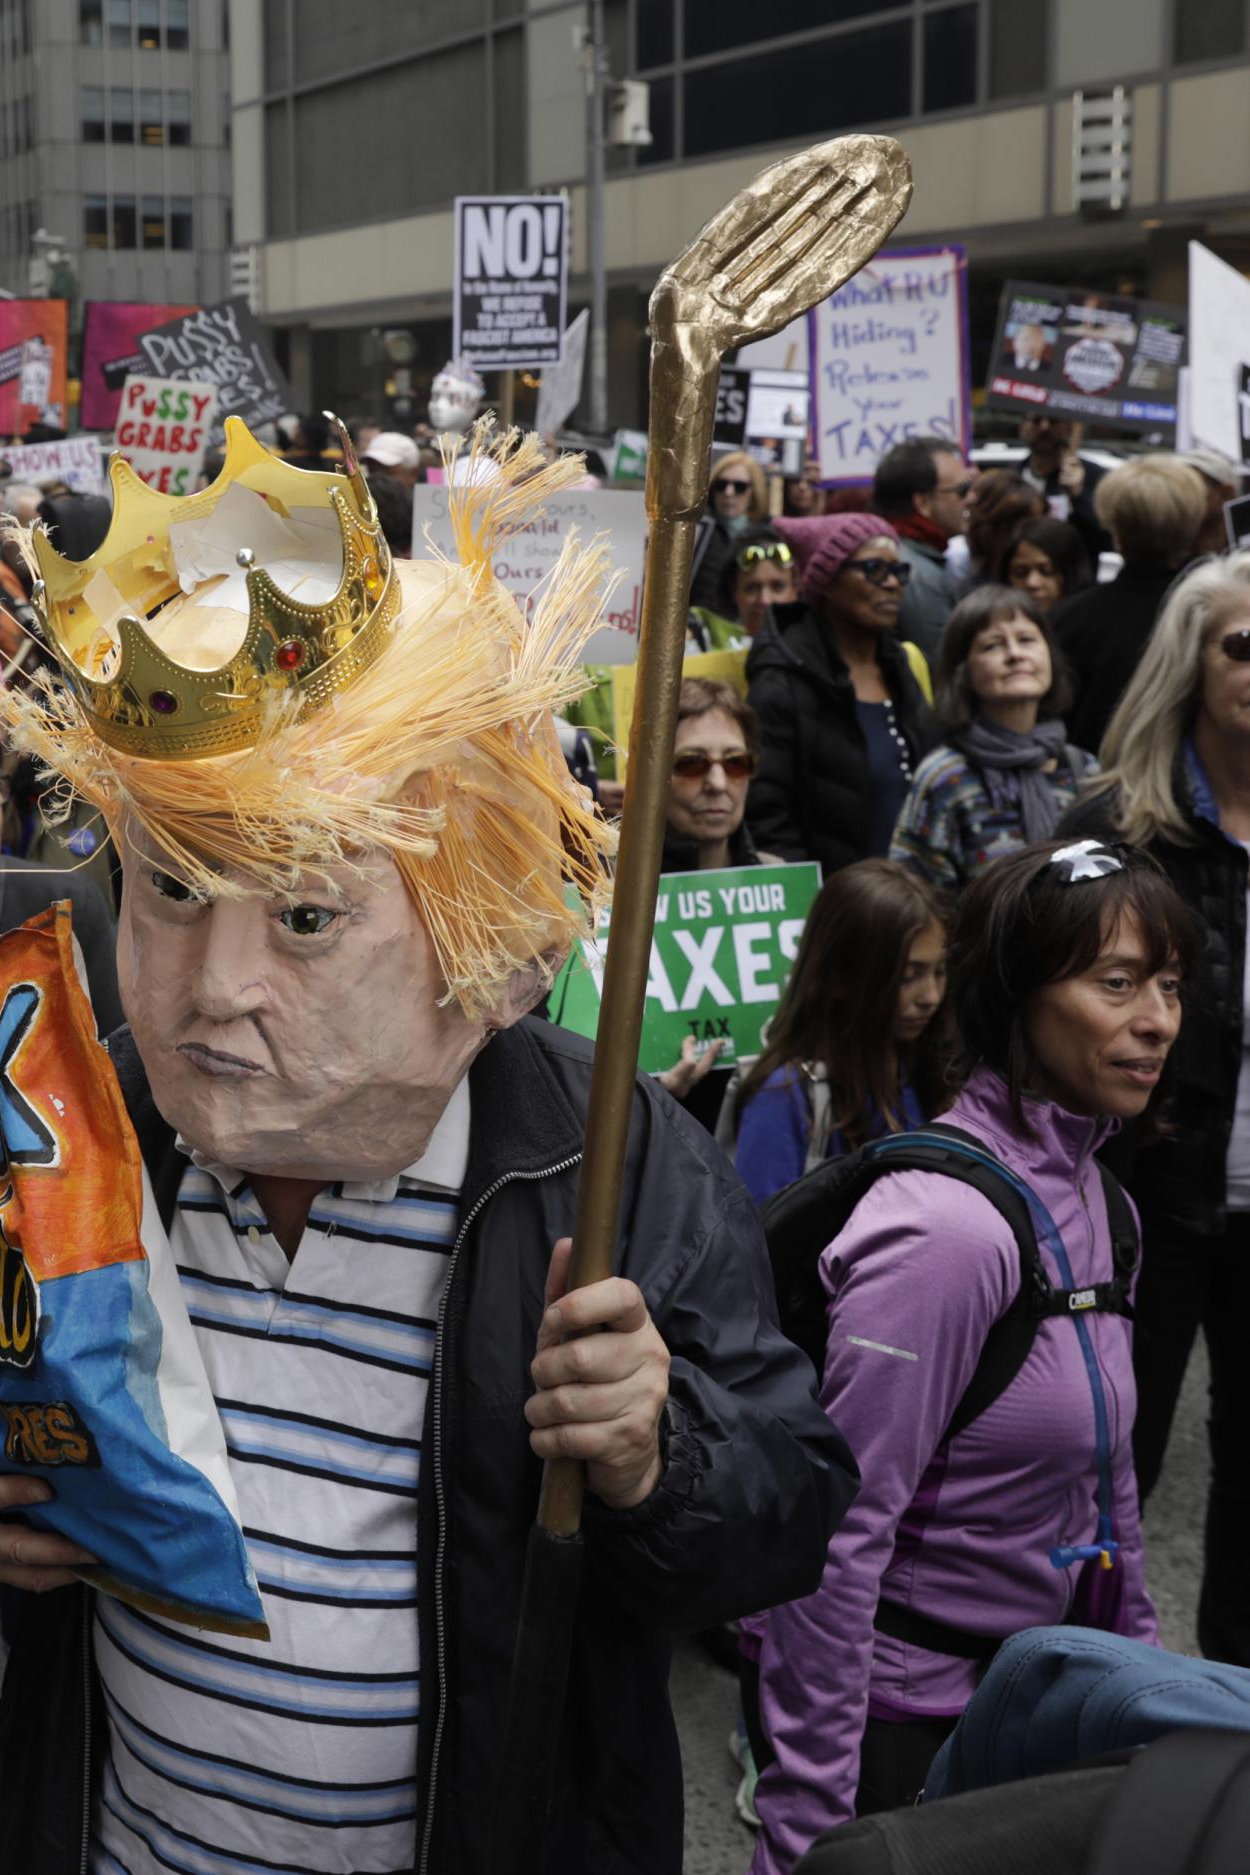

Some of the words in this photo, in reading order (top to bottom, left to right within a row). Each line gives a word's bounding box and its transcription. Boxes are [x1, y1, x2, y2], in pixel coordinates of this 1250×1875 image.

[463, 204, 561, 278] NO!
[141, 305, 242, 377] PUSSY
[120, 421, 203, 453] GRABS
[495, 563, 543, 580] Ours
[678, 890, 713, 920] US
[719, 884, 786, 915] YOUR
[687, 1017, 732, 1041] TAX
